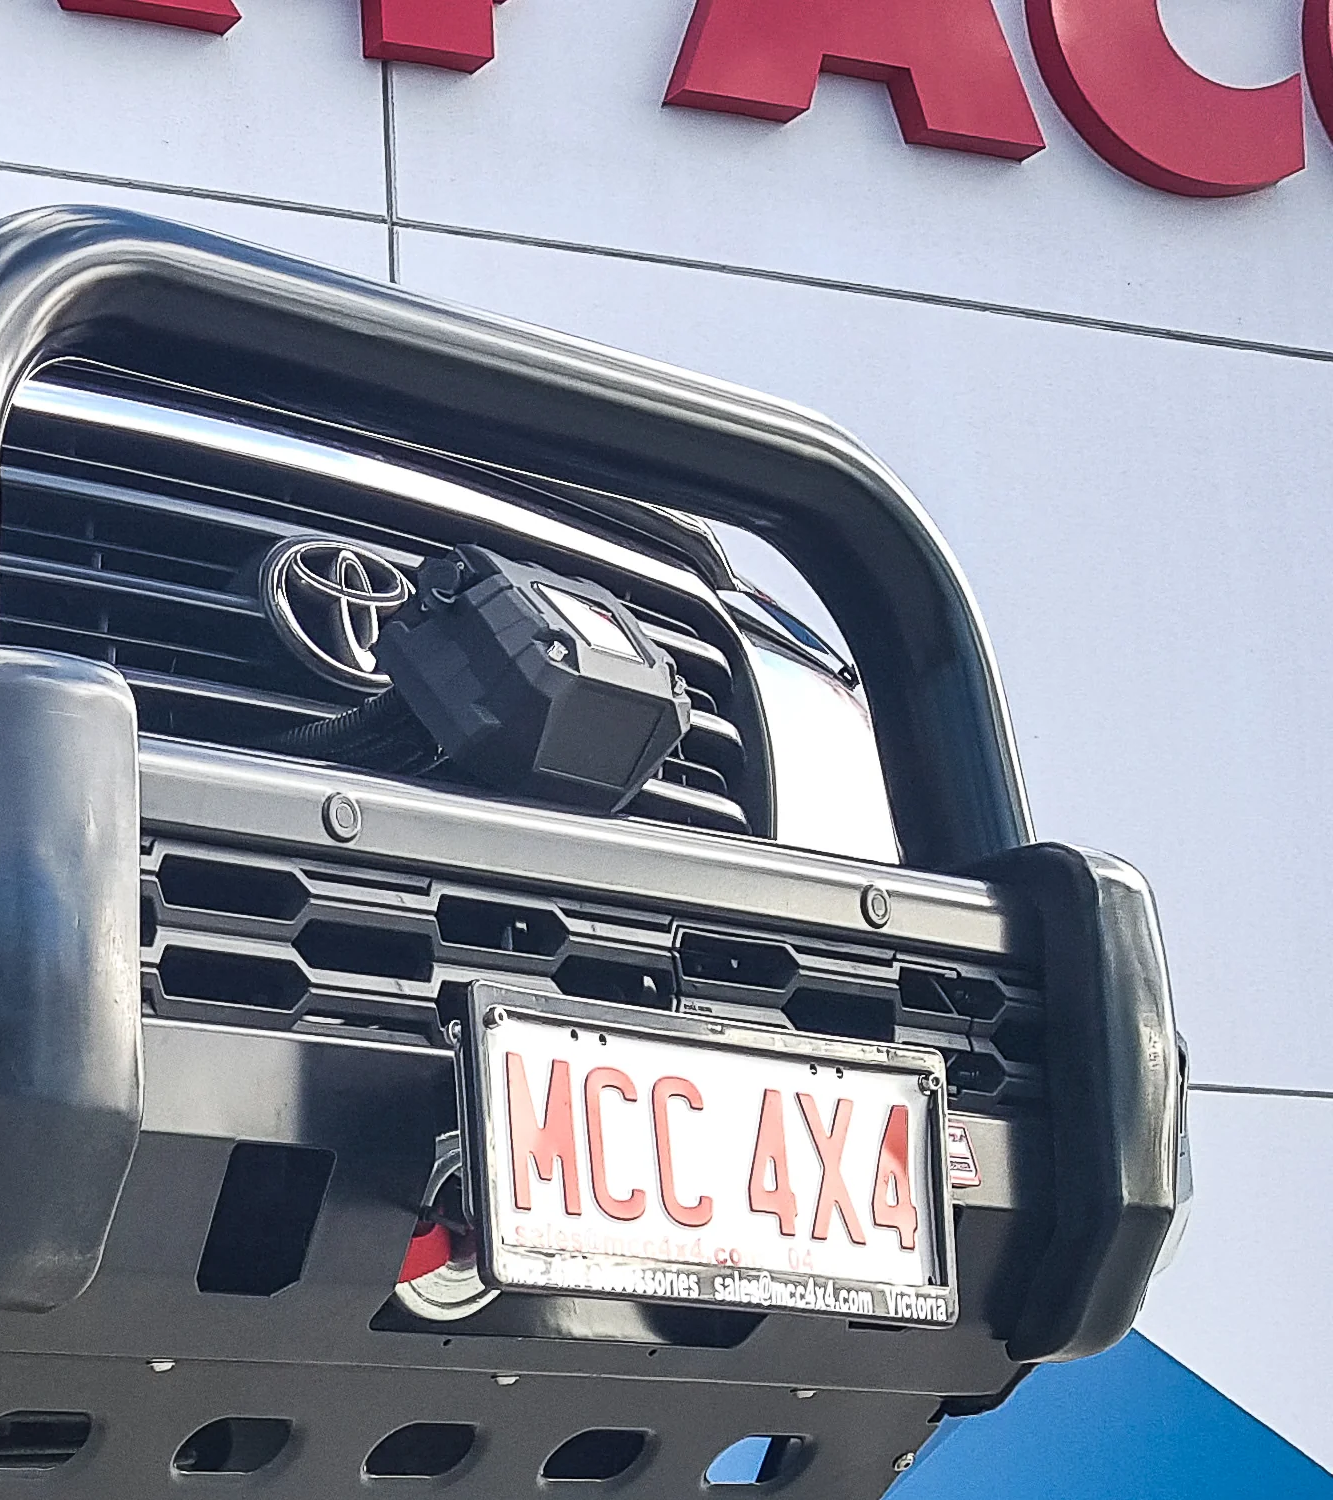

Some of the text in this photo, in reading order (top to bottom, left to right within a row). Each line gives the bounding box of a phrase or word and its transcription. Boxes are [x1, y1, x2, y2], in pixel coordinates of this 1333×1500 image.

[505, 1051, 919, 1252] MCC 4X4
[713, 1271, 874, 1314] sales@mcc4x4.com
[882, 1284, 948, 1322] Victoria
